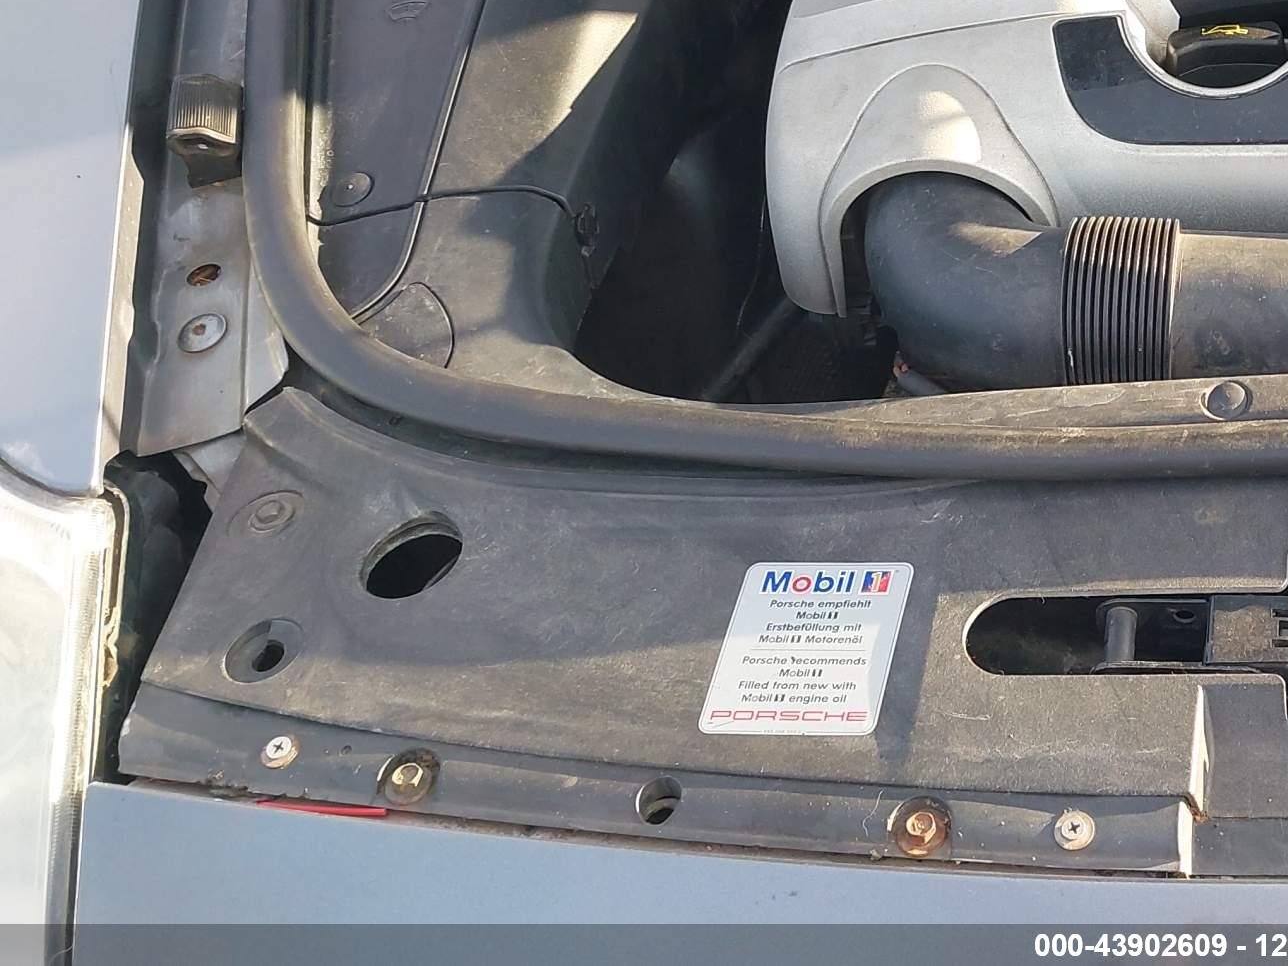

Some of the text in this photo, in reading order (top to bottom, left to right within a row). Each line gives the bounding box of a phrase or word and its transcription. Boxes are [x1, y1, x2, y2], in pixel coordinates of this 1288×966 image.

[761, 570, 855, 593] Mobil
[770, 600, 871, 609] Porsche empfiehlt
[796, 611, 826, 619] Mobil
[766, 623, 840, 633] Erstbefüllung
[759, 635, 862, 644] Mobil Motorenöl
[742, 656, 787, 665] Porsche
[779, 669, 810, 677] Mobil
[738, 681, 769, 689] Filled
[772, 681, 799, 690] from
[828, 682, 856, 690] with
[741, 694, 847, 704] Mobil engine oil
[710, 710, 867, 721] PORSCHE
